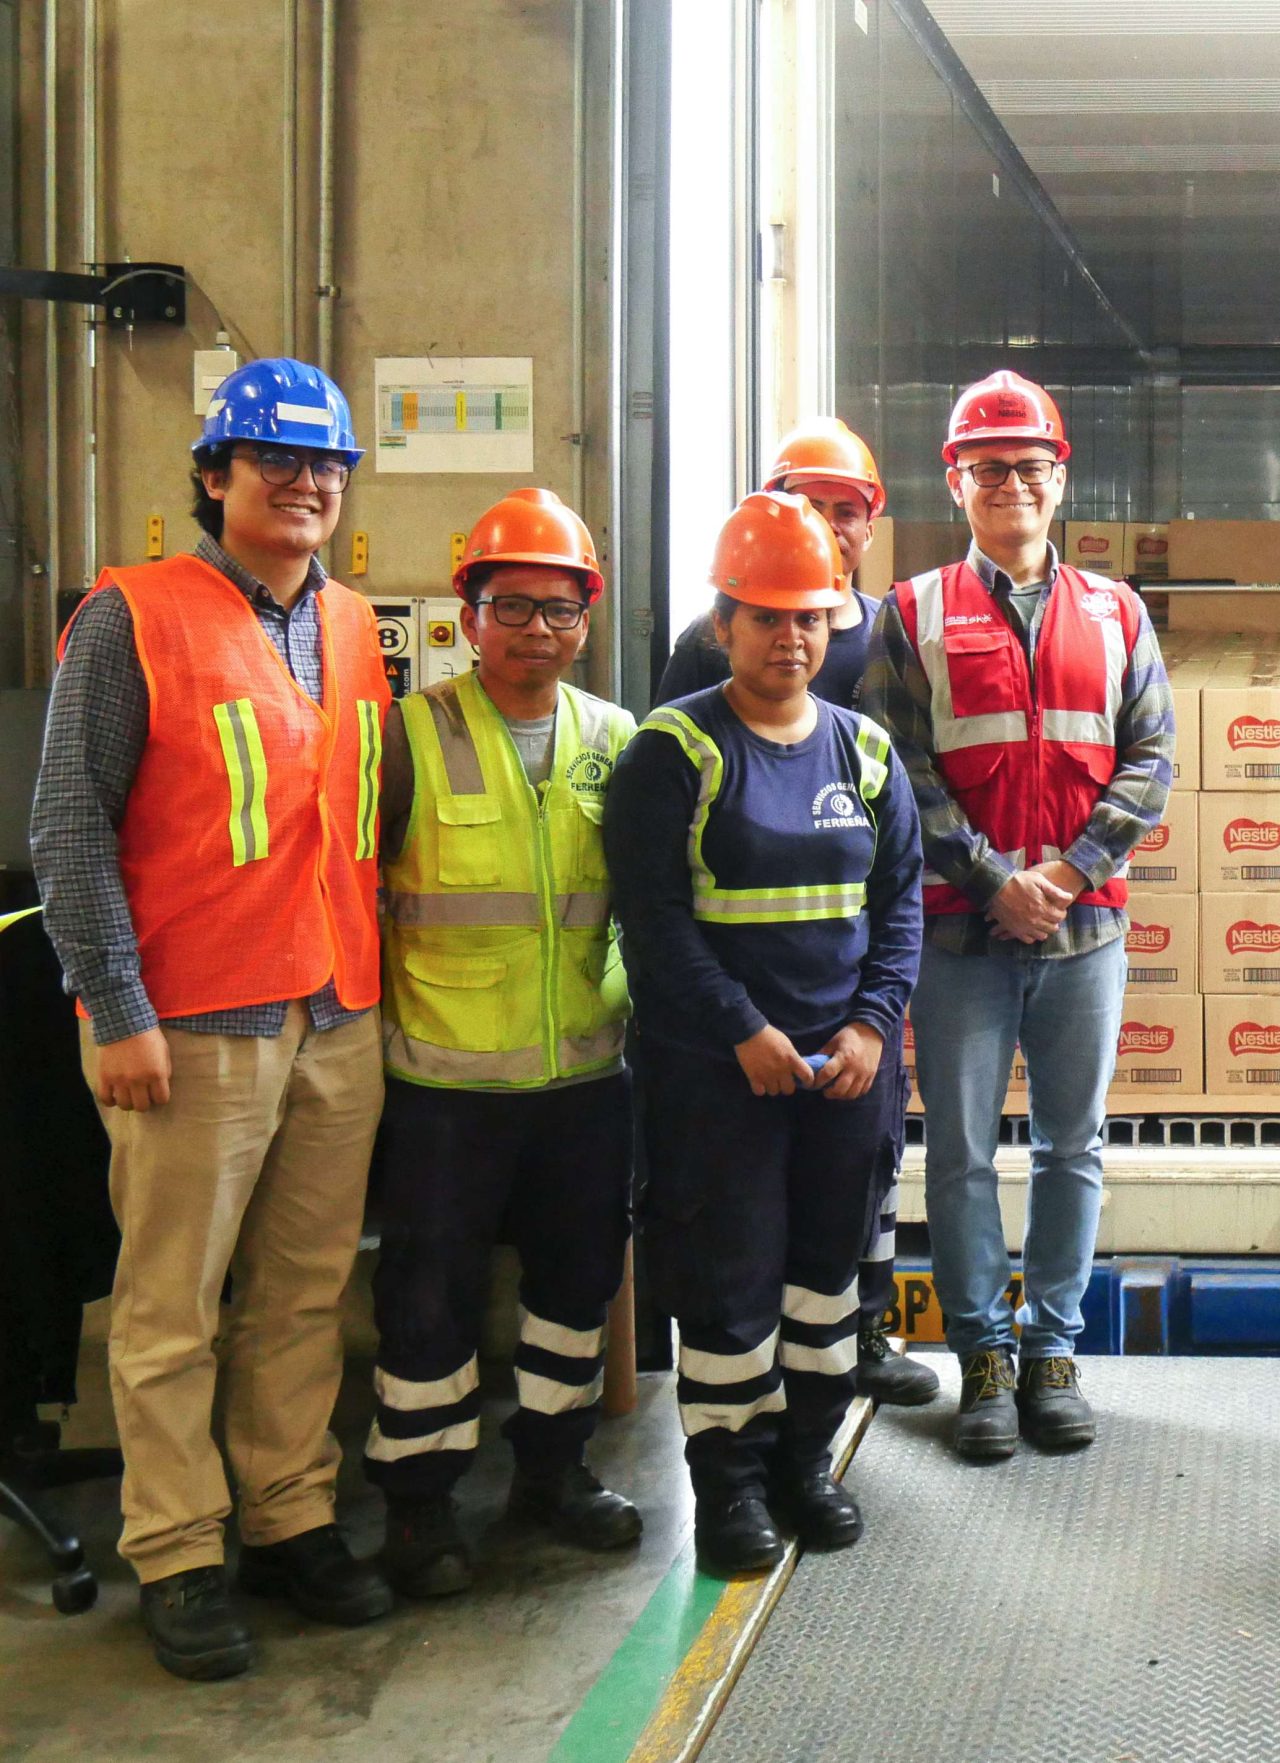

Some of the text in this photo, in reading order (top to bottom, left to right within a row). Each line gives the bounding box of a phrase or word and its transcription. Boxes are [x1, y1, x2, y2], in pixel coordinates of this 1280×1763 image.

[378, 628, 400, 649] 8
[812, 782, 837, 815] SERVICIOS
[1229, 826, 1279, 842] Nestlé
[1127, 930, 1165, 944] estlé
[1231, 928, 1280, 944] Nestlé
[1119, 1030, 1169, 1045] Nestlé
